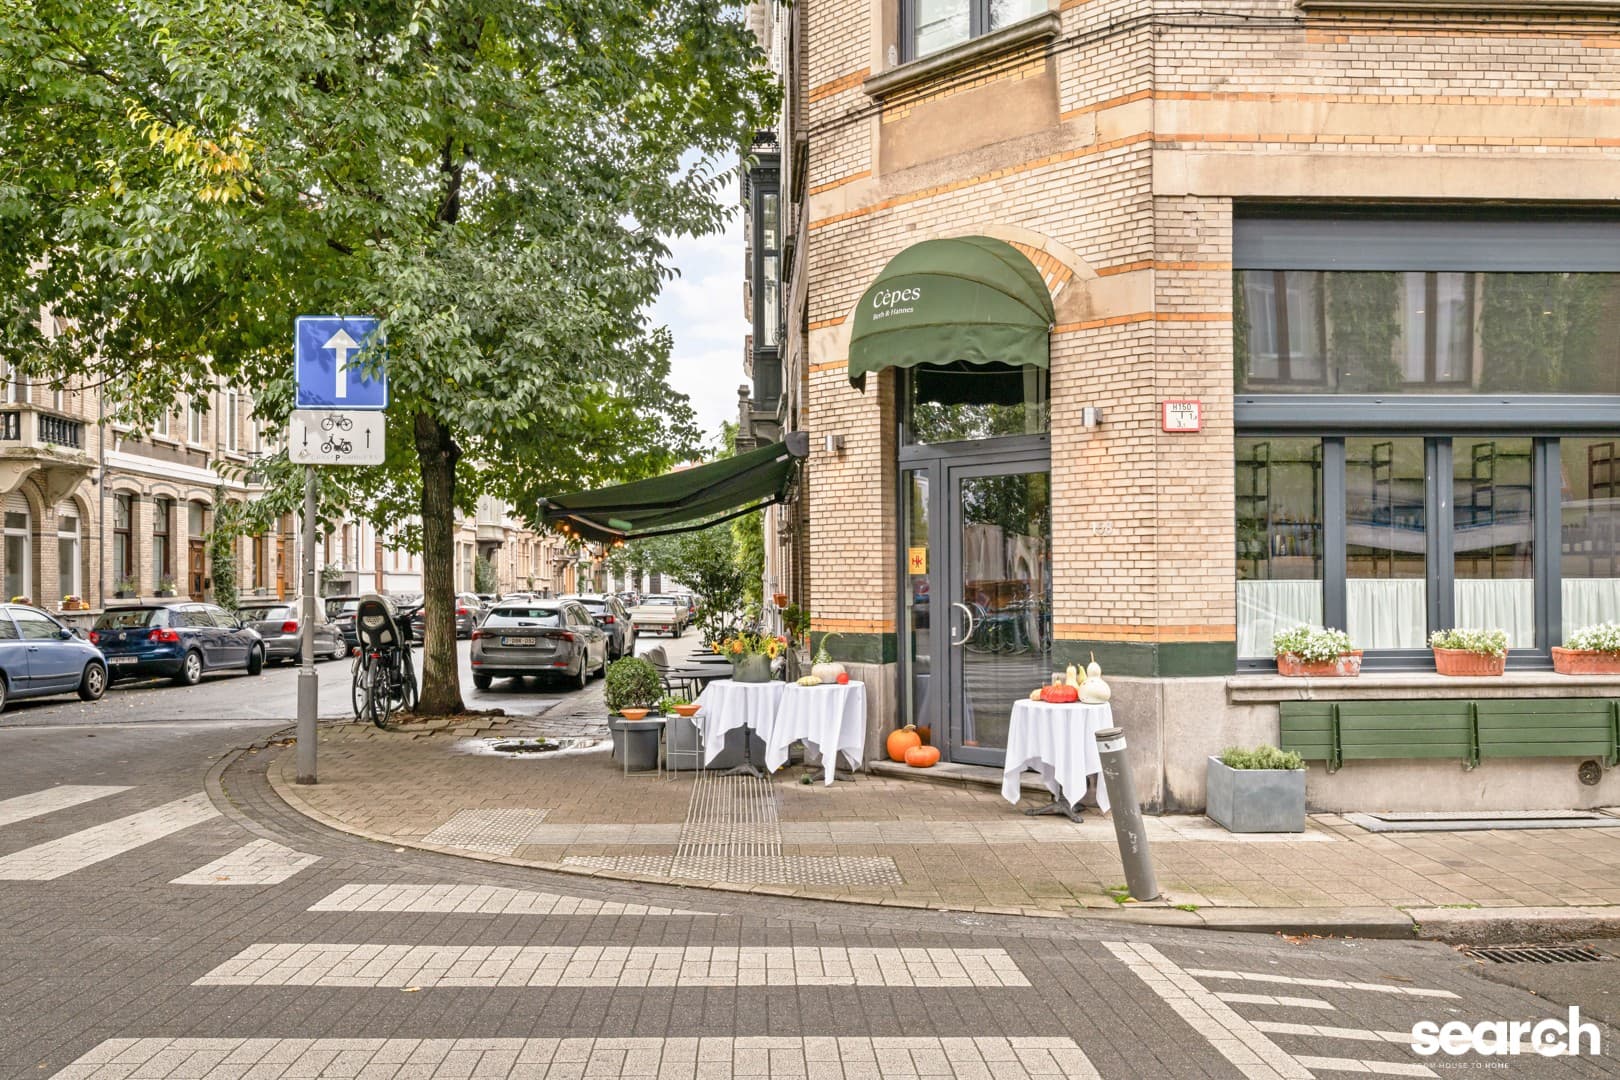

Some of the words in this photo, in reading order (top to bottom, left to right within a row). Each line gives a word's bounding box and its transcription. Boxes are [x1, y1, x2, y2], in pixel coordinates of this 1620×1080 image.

[873, 287, 921, 308] Cèpes
[891, 307, 914, 316] Hannes
[335, 454, 341, 462] P
